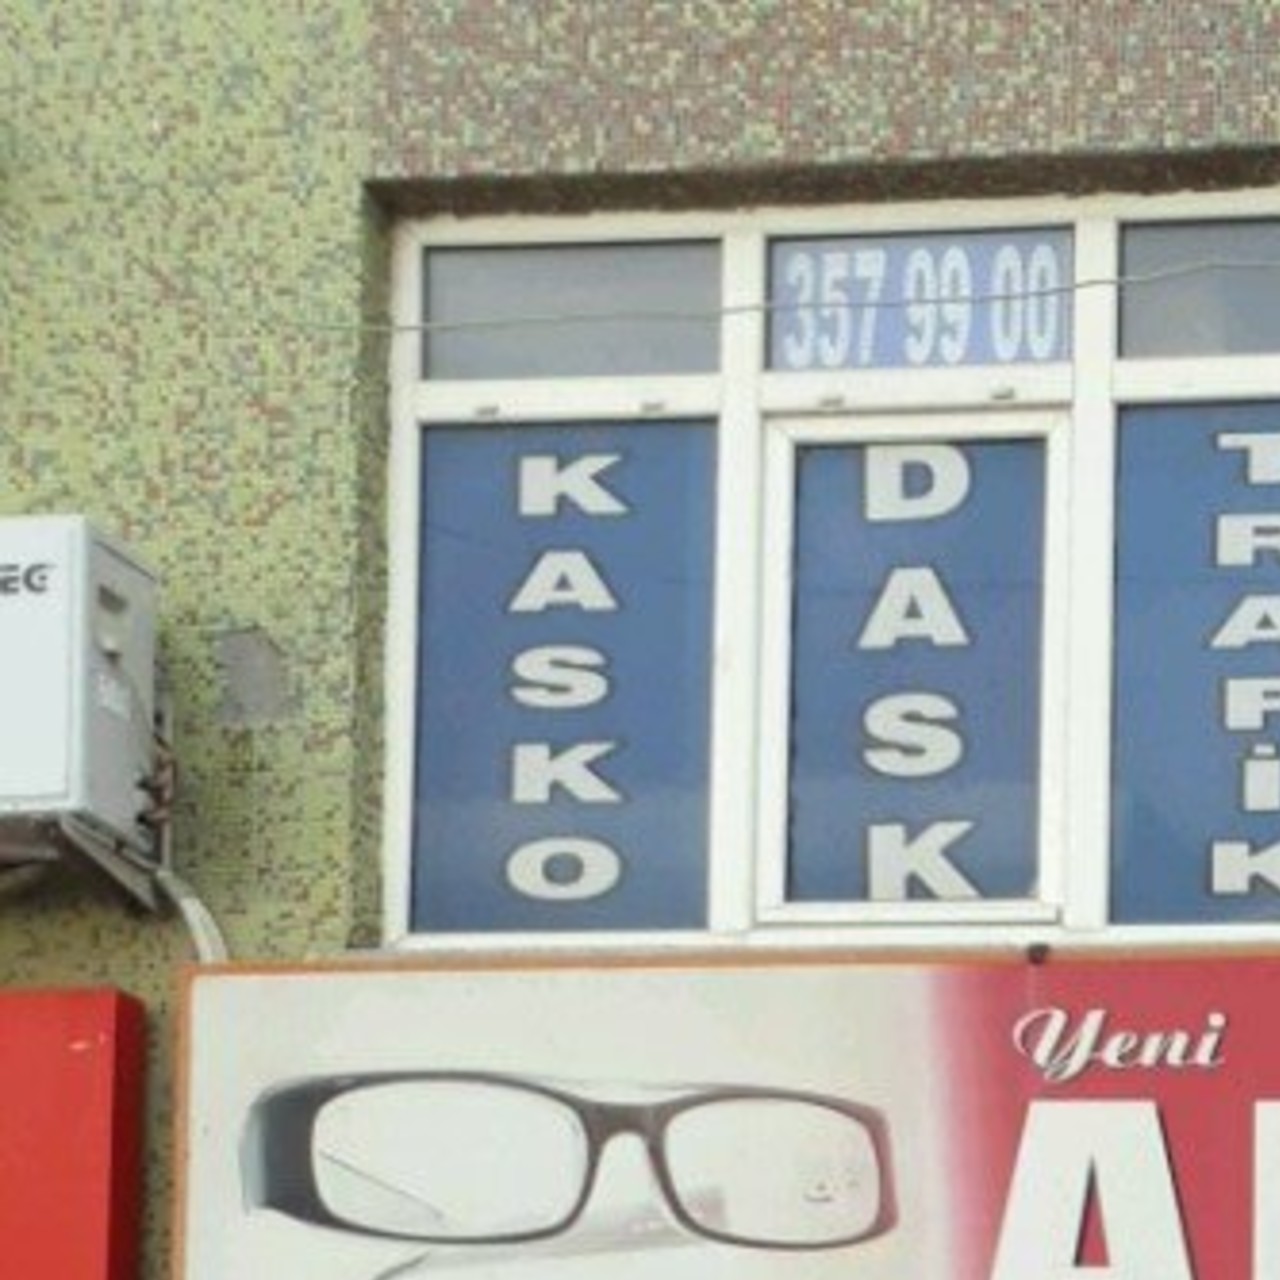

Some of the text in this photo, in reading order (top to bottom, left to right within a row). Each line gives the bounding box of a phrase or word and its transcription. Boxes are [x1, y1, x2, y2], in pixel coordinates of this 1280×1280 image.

[781, 243, 1059, 367] 357 99 00
[506, 455, 628, 900] KASKO
[857, 445, 981, 899] DASK
[1012, 1007, 1228, 1081] Yeni
